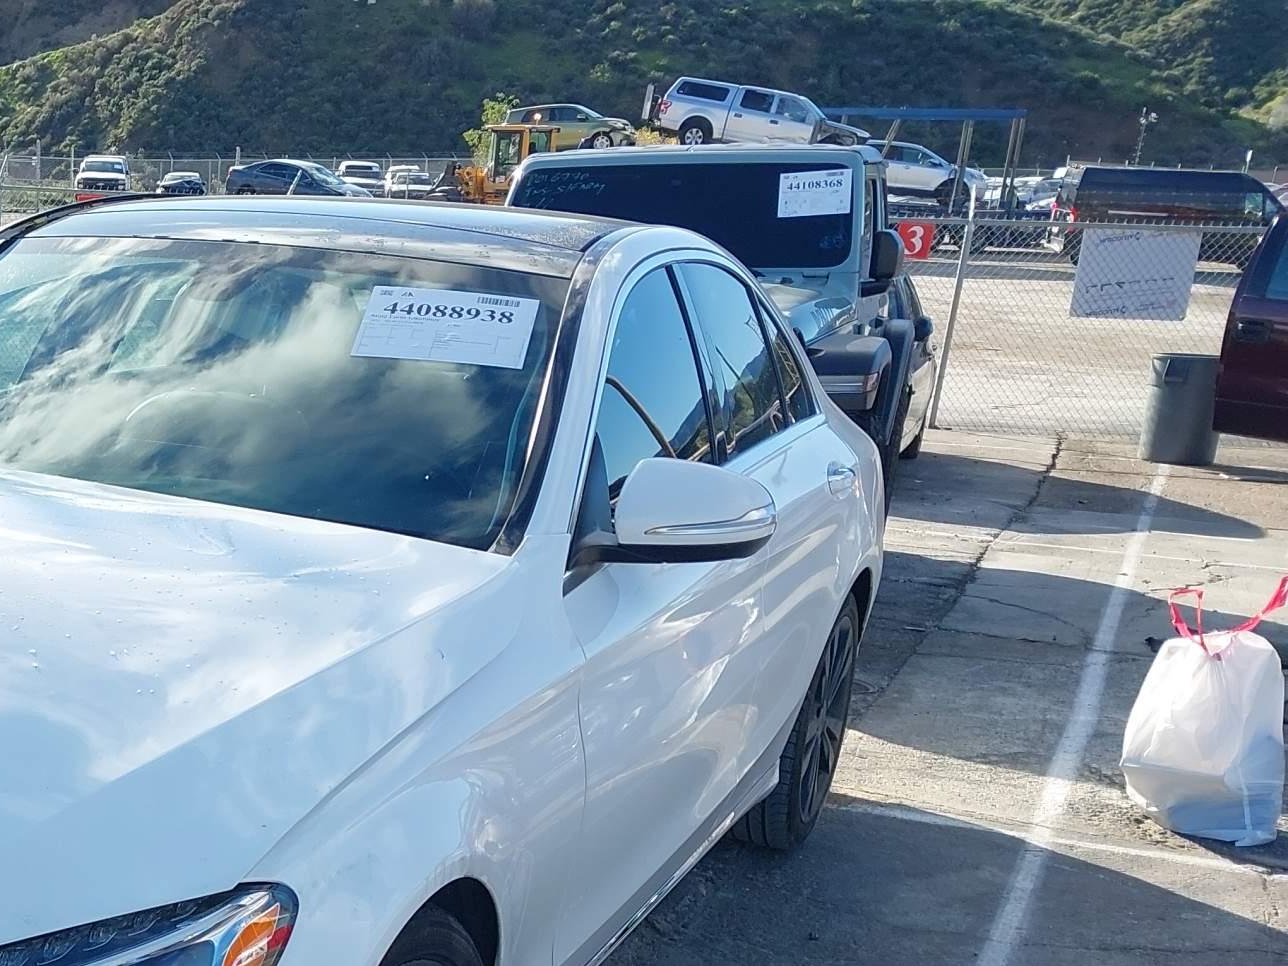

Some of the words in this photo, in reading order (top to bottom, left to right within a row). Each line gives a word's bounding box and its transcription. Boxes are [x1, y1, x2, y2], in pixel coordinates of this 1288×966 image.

[786, 178, 844, 191] 44108368
[903, 225, 925, 255] 3
[383, 301, 515, 325] 44088938
